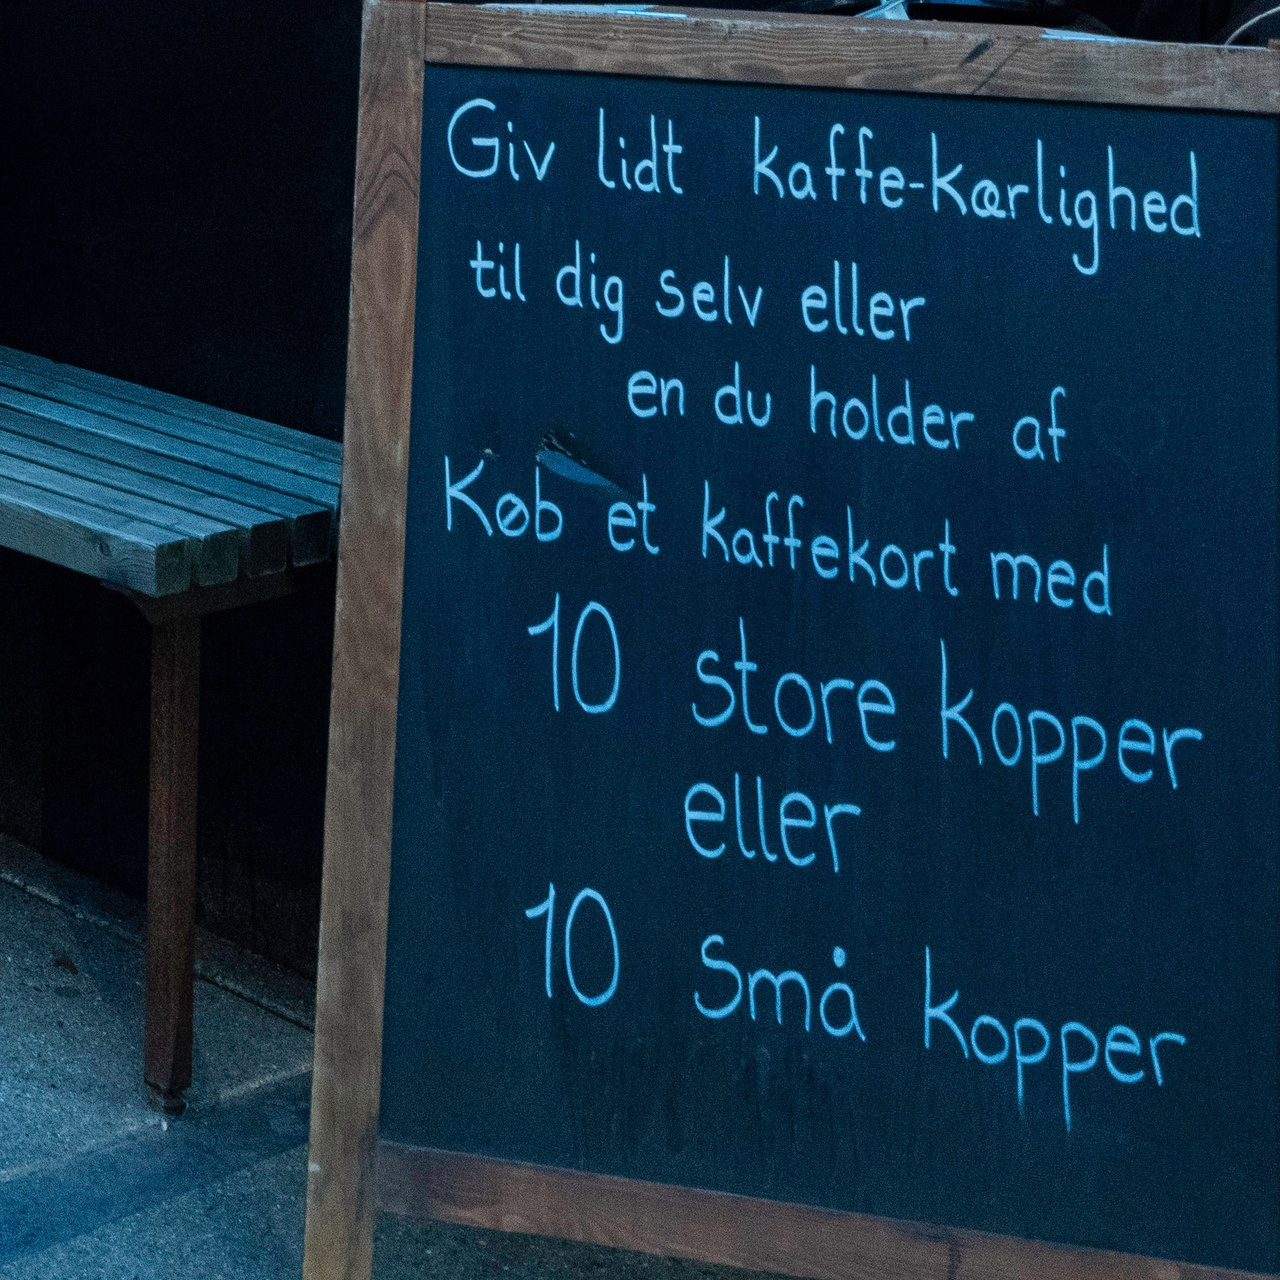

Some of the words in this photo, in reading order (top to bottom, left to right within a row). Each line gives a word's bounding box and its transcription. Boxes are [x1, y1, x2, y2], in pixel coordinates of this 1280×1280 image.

[446, 98, 556, 182] Giv
[598, 107, 684, 195] lidt
[469, 240, 527, 303] til
[556, 240, 625, 345] dig
[656, 255, 764, 328] selv
[801, 260, 927, 342] eller
[626, 369, 685, 419] en
[714, 361, 772, 428] du
[809, 365, 976, 450] holder
[1011, 386, 1067, 463] af
[445, 456, 564, 543] Køb
[608, 473, 660, 556] et
[702, 480, 960, 598] kaffekort
[990, 543, 1113, 617] med
[527, 593, 621, 714] 10
[691, 617, 897, 753] store
[940, 639, 1204, 825] kopper
[683, 772, 862, 874] eller
[524, 883, 621, 1008] 10
[924, 946, 1187, 1132] kopper
